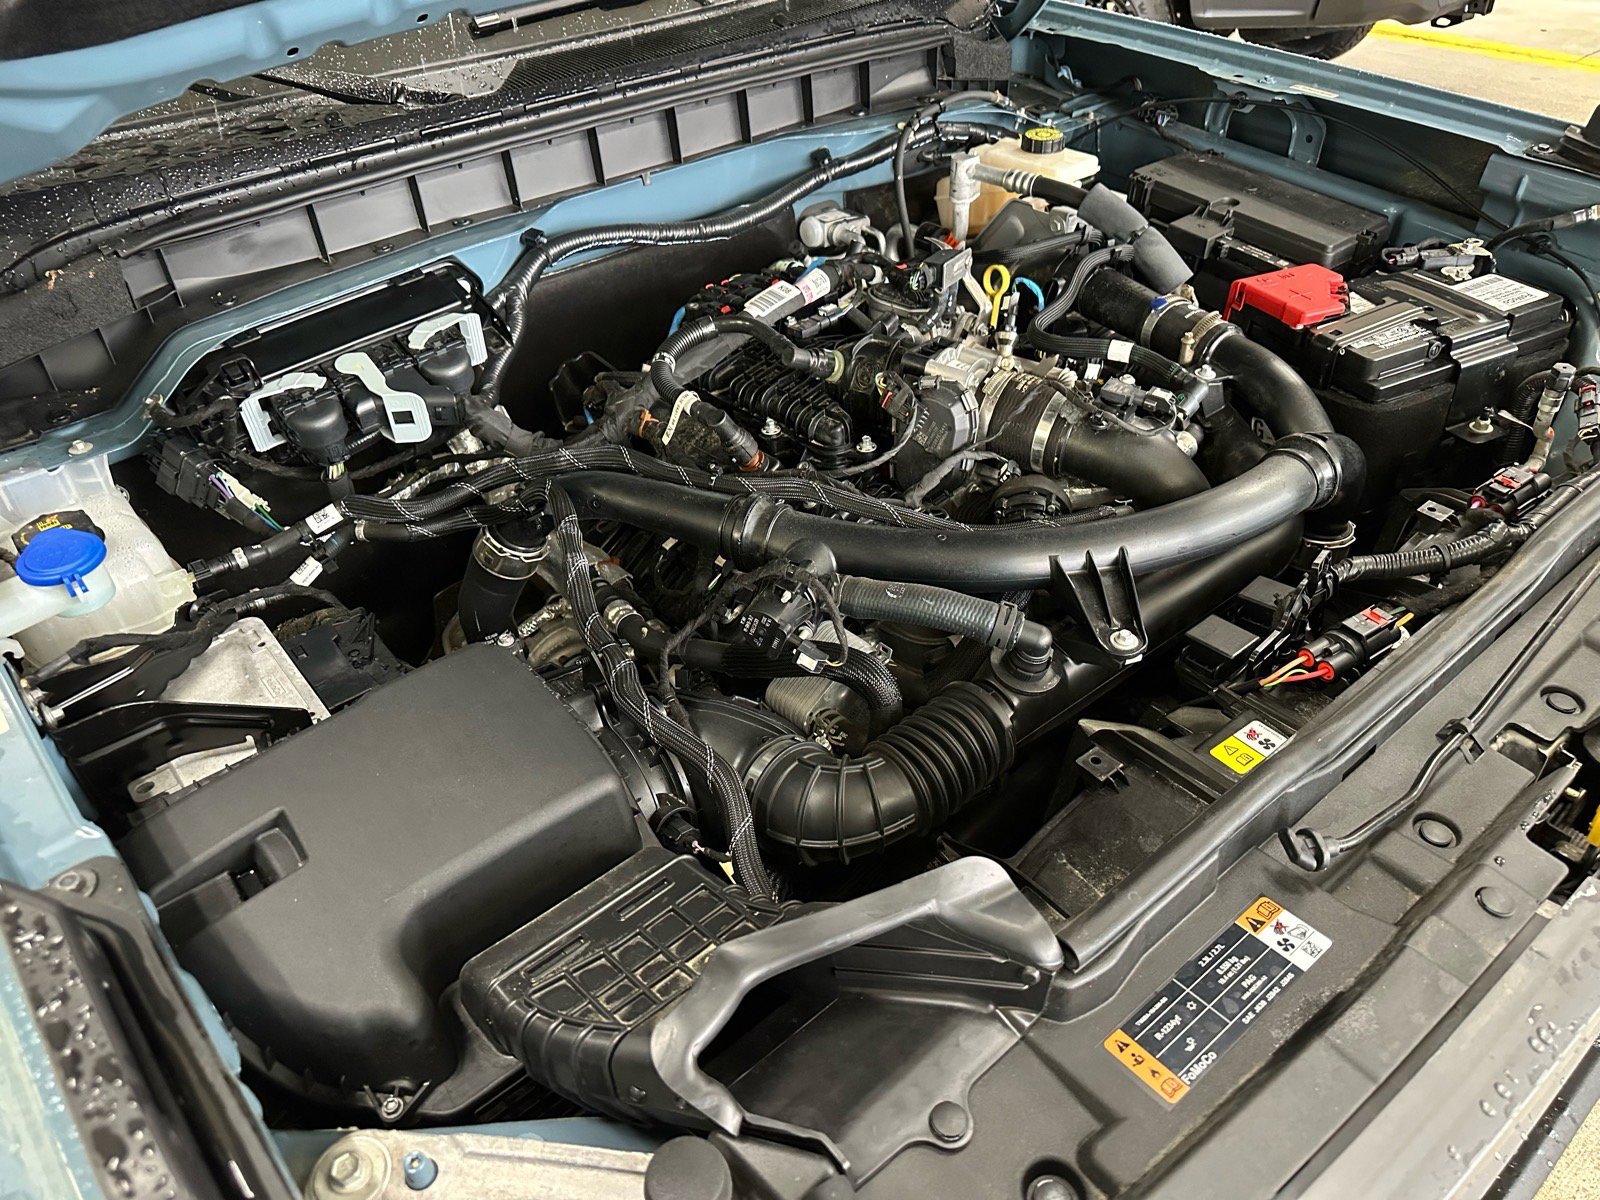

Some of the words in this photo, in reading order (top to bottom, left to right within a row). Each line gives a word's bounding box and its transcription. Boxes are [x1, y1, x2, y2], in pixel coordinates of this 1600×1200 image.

[1241, 974, 1257, 988] PAG
[1154, 1014, 1182, 1041] R-1234yf
[1180, 1051, 1218, 1085] FoMoCo
